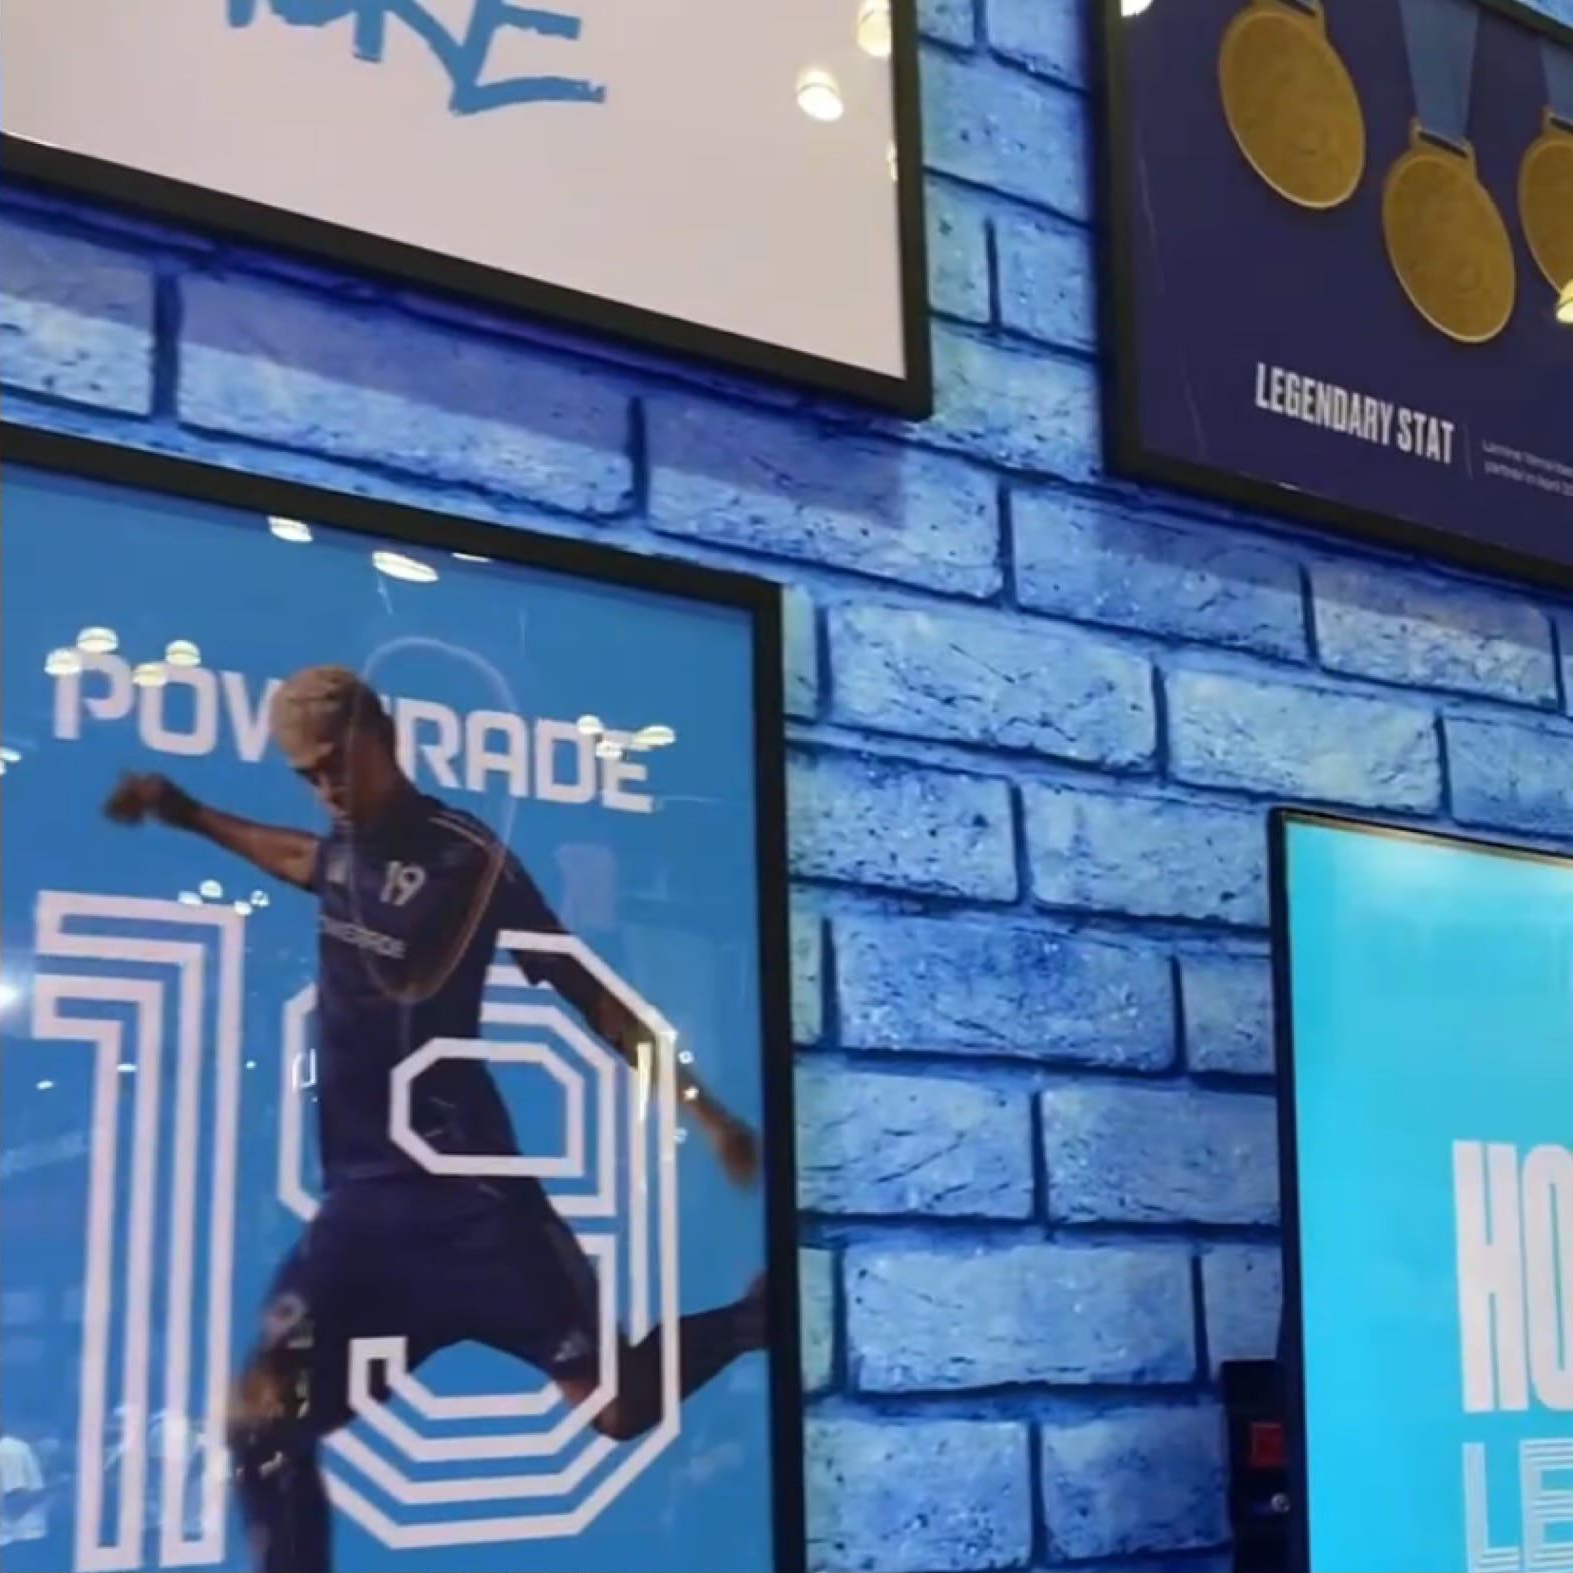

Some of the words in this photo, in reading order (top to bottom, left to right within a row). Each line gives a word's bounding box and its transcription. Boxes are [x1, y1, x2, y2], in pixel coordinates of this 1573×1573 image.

[1253, 361, 1394, 446] LEGENDARY
[1395, 406, 1455, 465] STAT
[52, 648, 655, 815] POWRADE
[379, 859, 426, 906] 19
[31, 889, 681, 1573] 19
